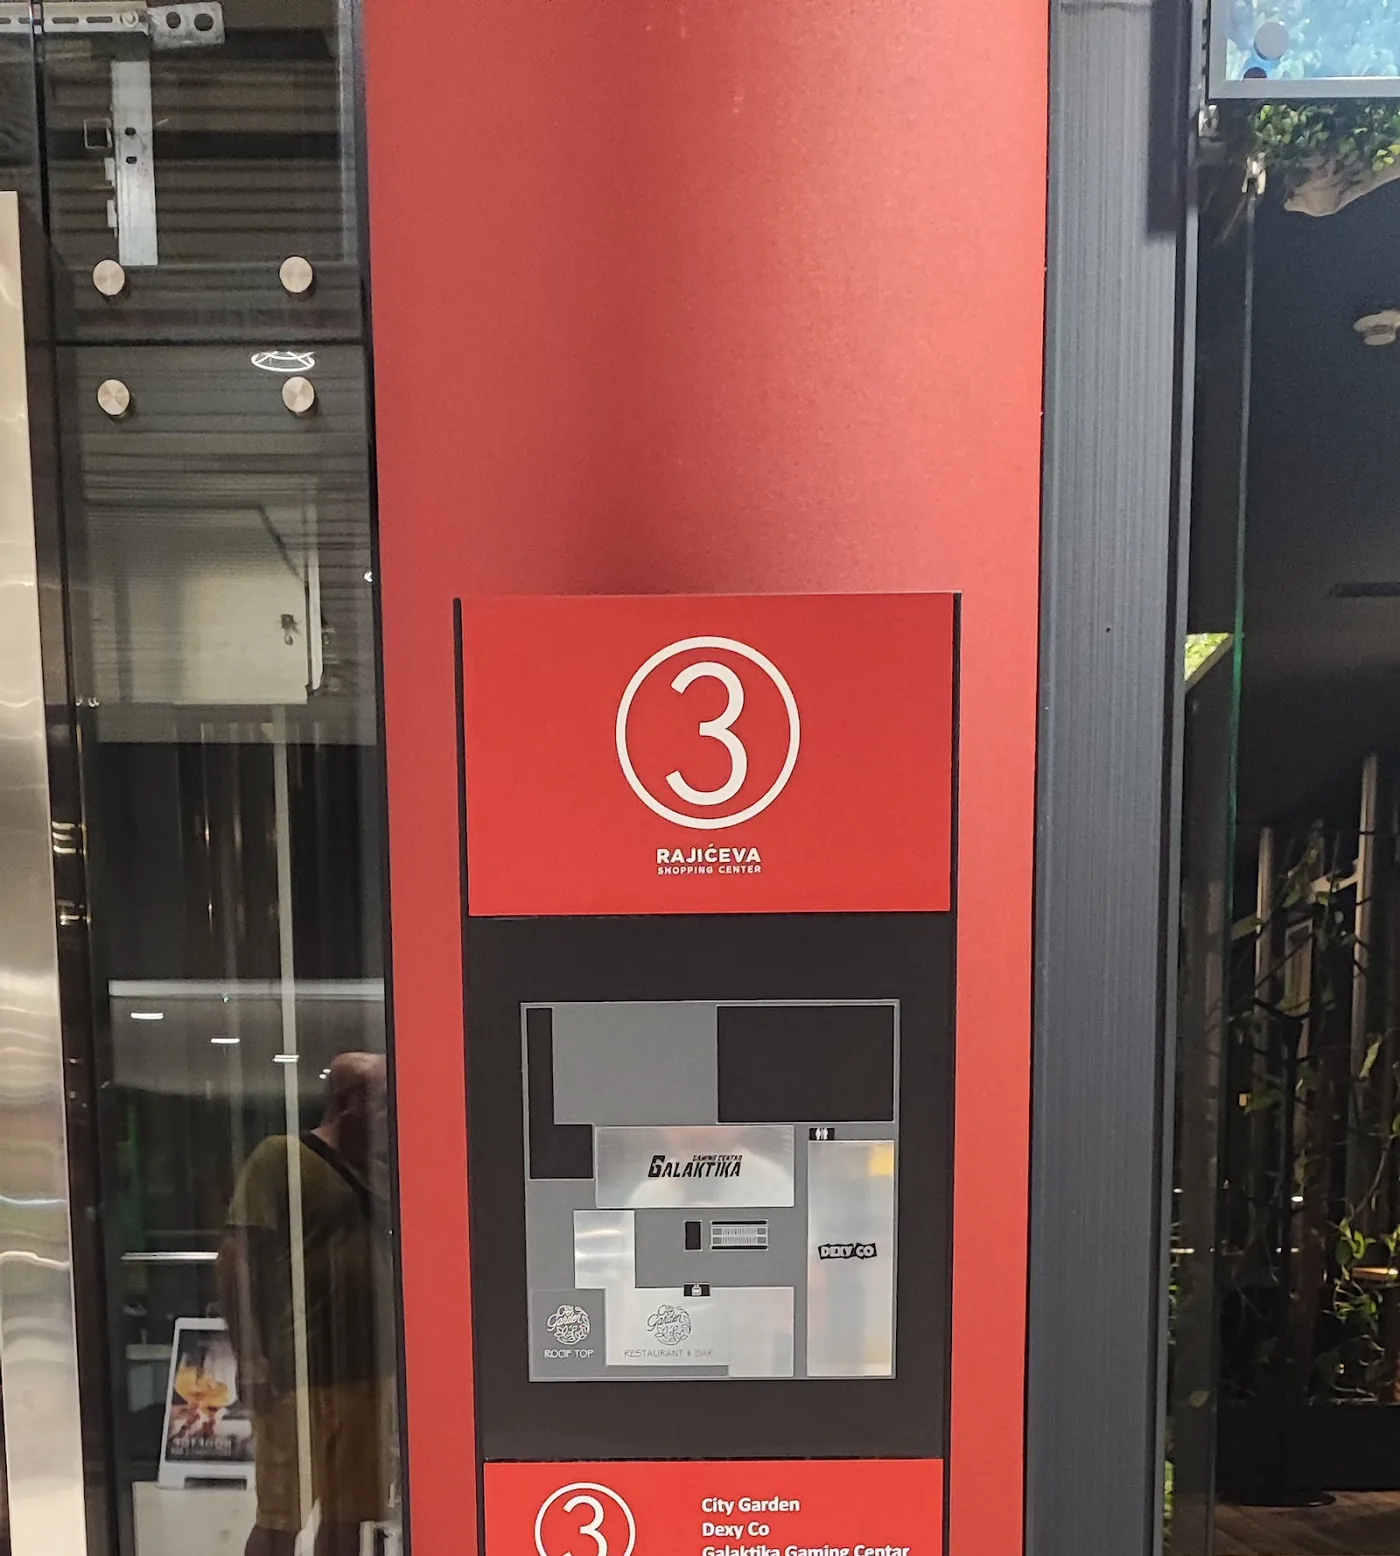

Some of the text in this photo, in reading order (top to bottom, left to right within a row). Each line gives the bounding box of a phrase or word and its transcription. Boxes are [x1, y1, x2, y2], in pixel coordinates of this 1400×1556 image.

[664, 660, 749, 806] 3
[656, 843, 762, 863] RAJIĆEVA
[657, 865, 762, 875] SHOPPING CENTER
[648, 1154, 741, 1178] GALAKTIKA
[820, 1244, 875, 1258] DEXY CO
[544, 1349, 594, 1358] ROOF TOP
[624, 1349, 684, 1358] RESTAURANT
[702, 1496, 800, 1515] City Garden
[702, 1522, 770, 1540] Dexy Co
